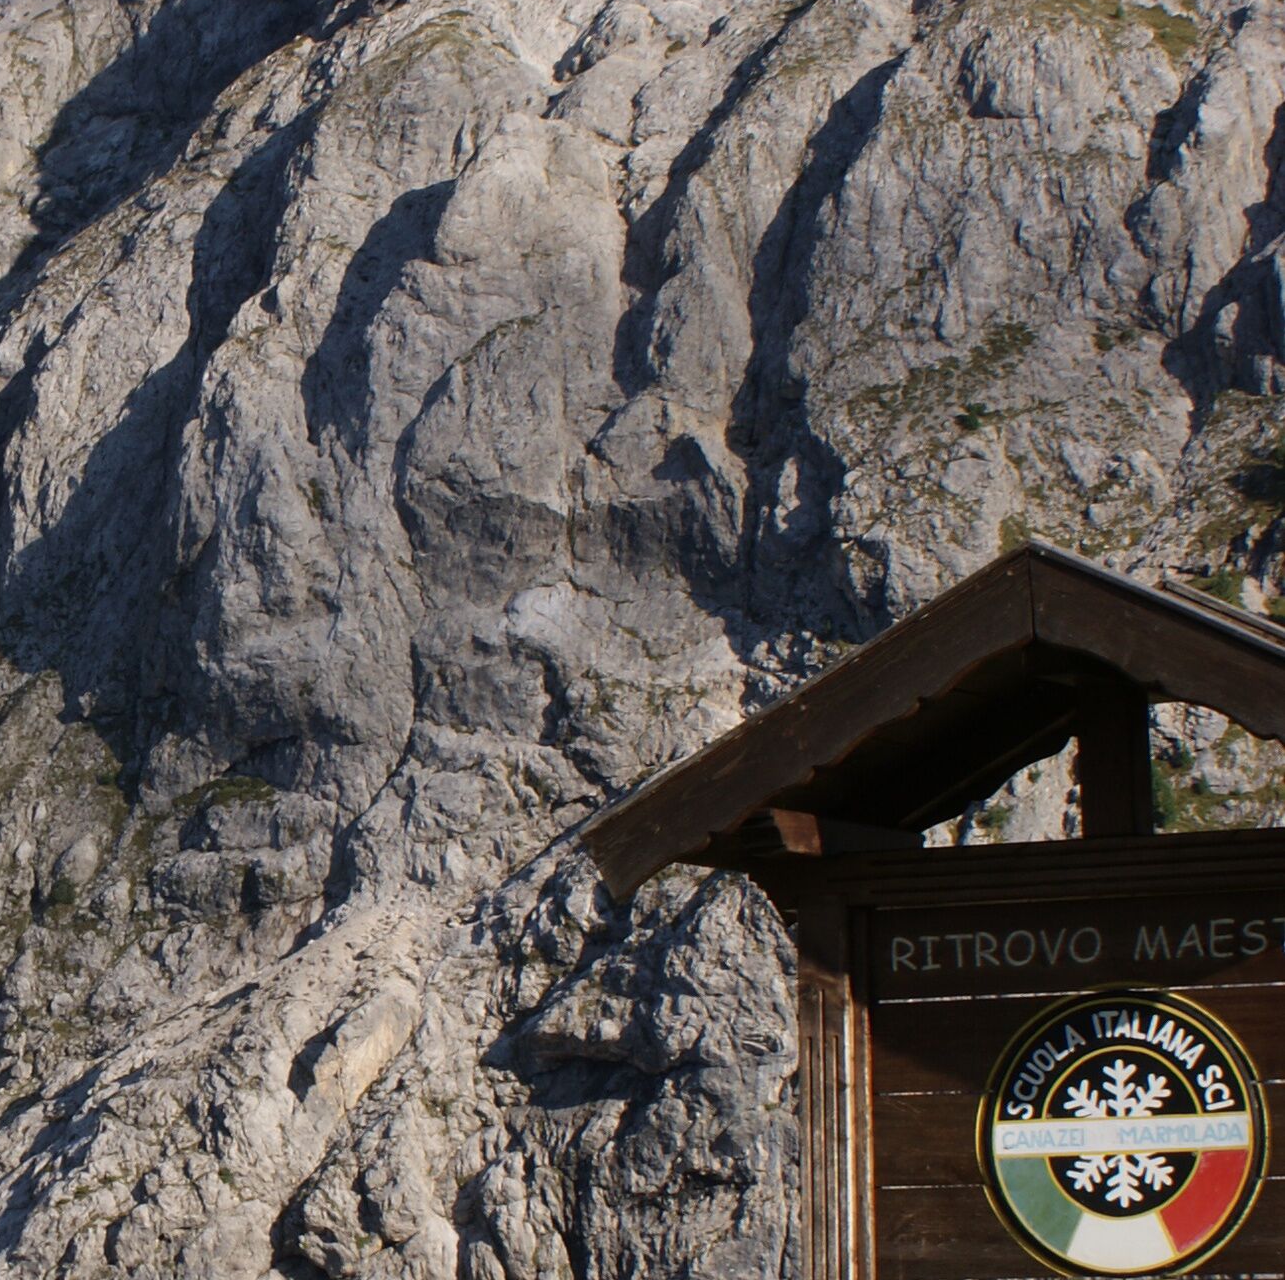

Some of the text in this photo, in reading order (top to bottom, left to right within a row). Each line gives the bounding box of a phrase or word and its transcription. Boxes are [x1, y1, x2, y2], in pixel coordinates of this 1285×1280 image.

[890, 926, 1102, 972] RITROVO
[1006, 1010, 1235, 1120] SCUOLA ITALIANA SCI
[1002, 1122, 1244, 1149] CANAZEI MARMOLADA
